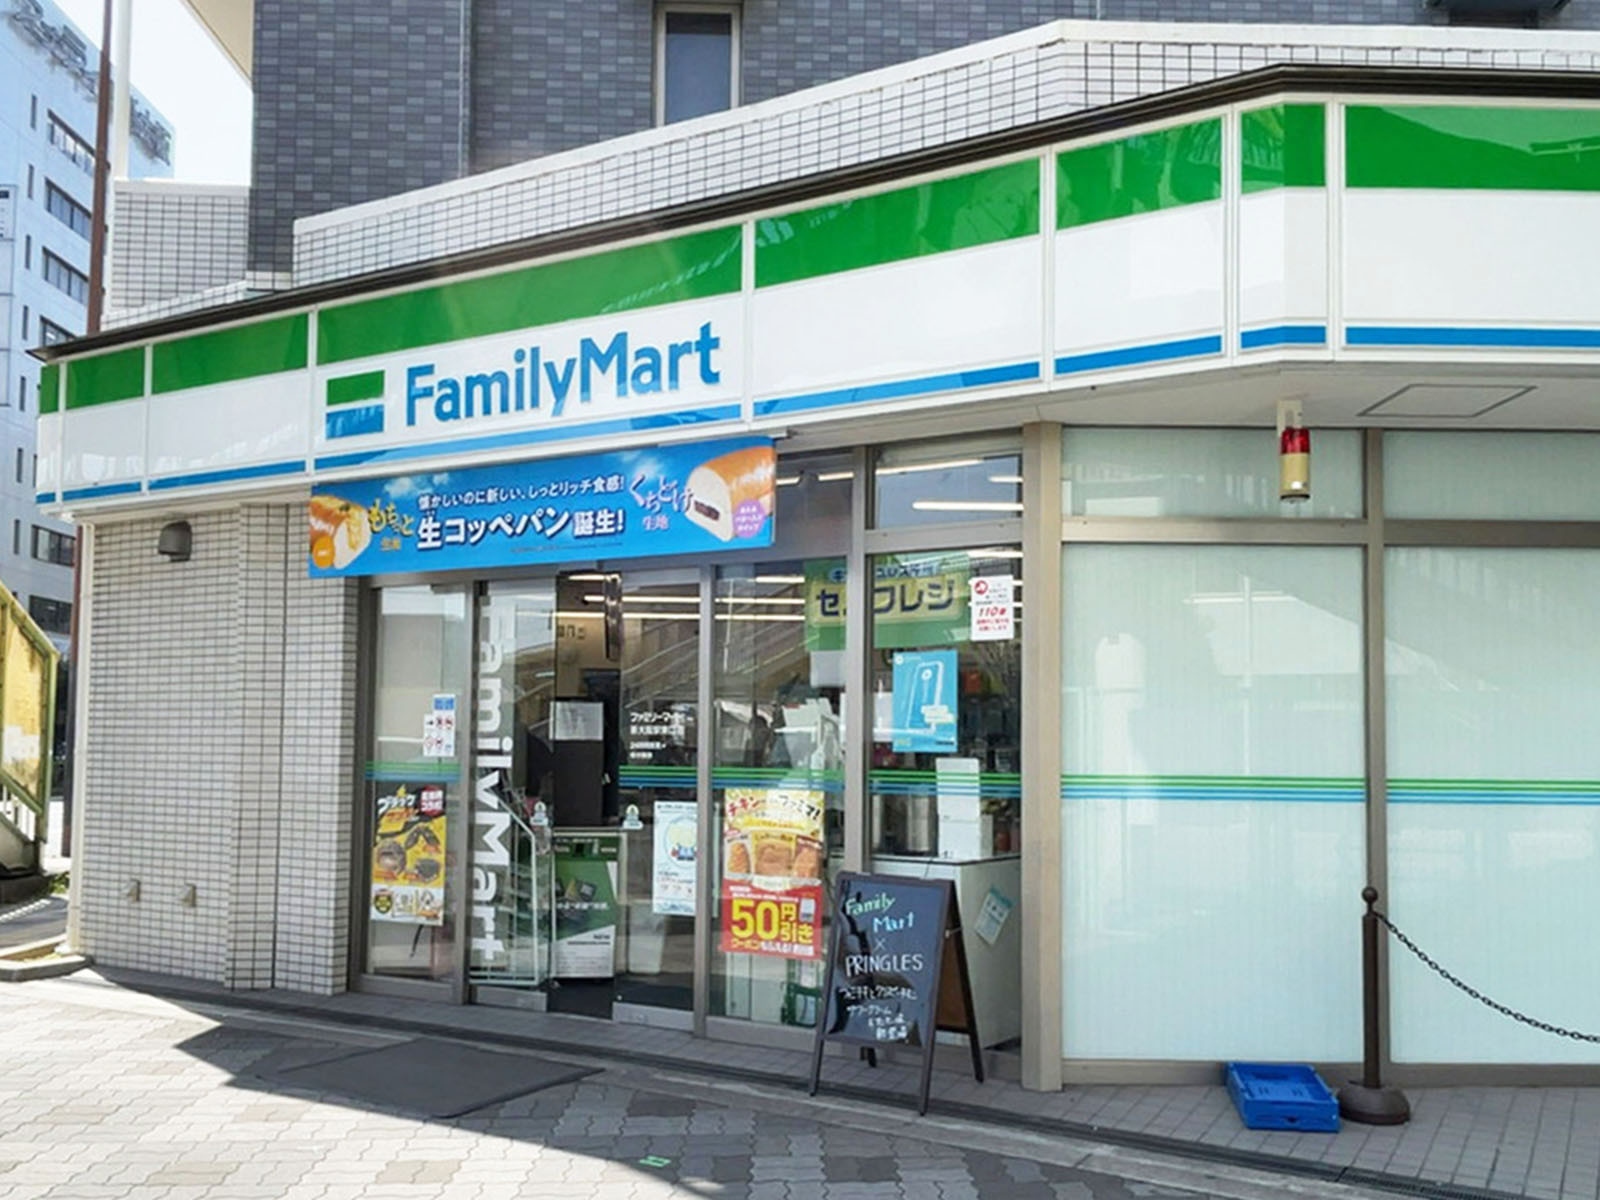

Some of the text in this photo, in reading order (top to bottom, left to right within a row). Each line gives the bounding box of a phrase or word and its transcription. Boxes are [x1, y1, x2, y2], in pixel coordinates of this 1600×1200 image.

[406, 321, 721, 427] FamilyMart
[815, 579, 954, 617] セフレジ
[845, 892, 896, 916] Family
[872, 912, 914, 933] Mart
[845, 953, 924, 977] PRINGLES
